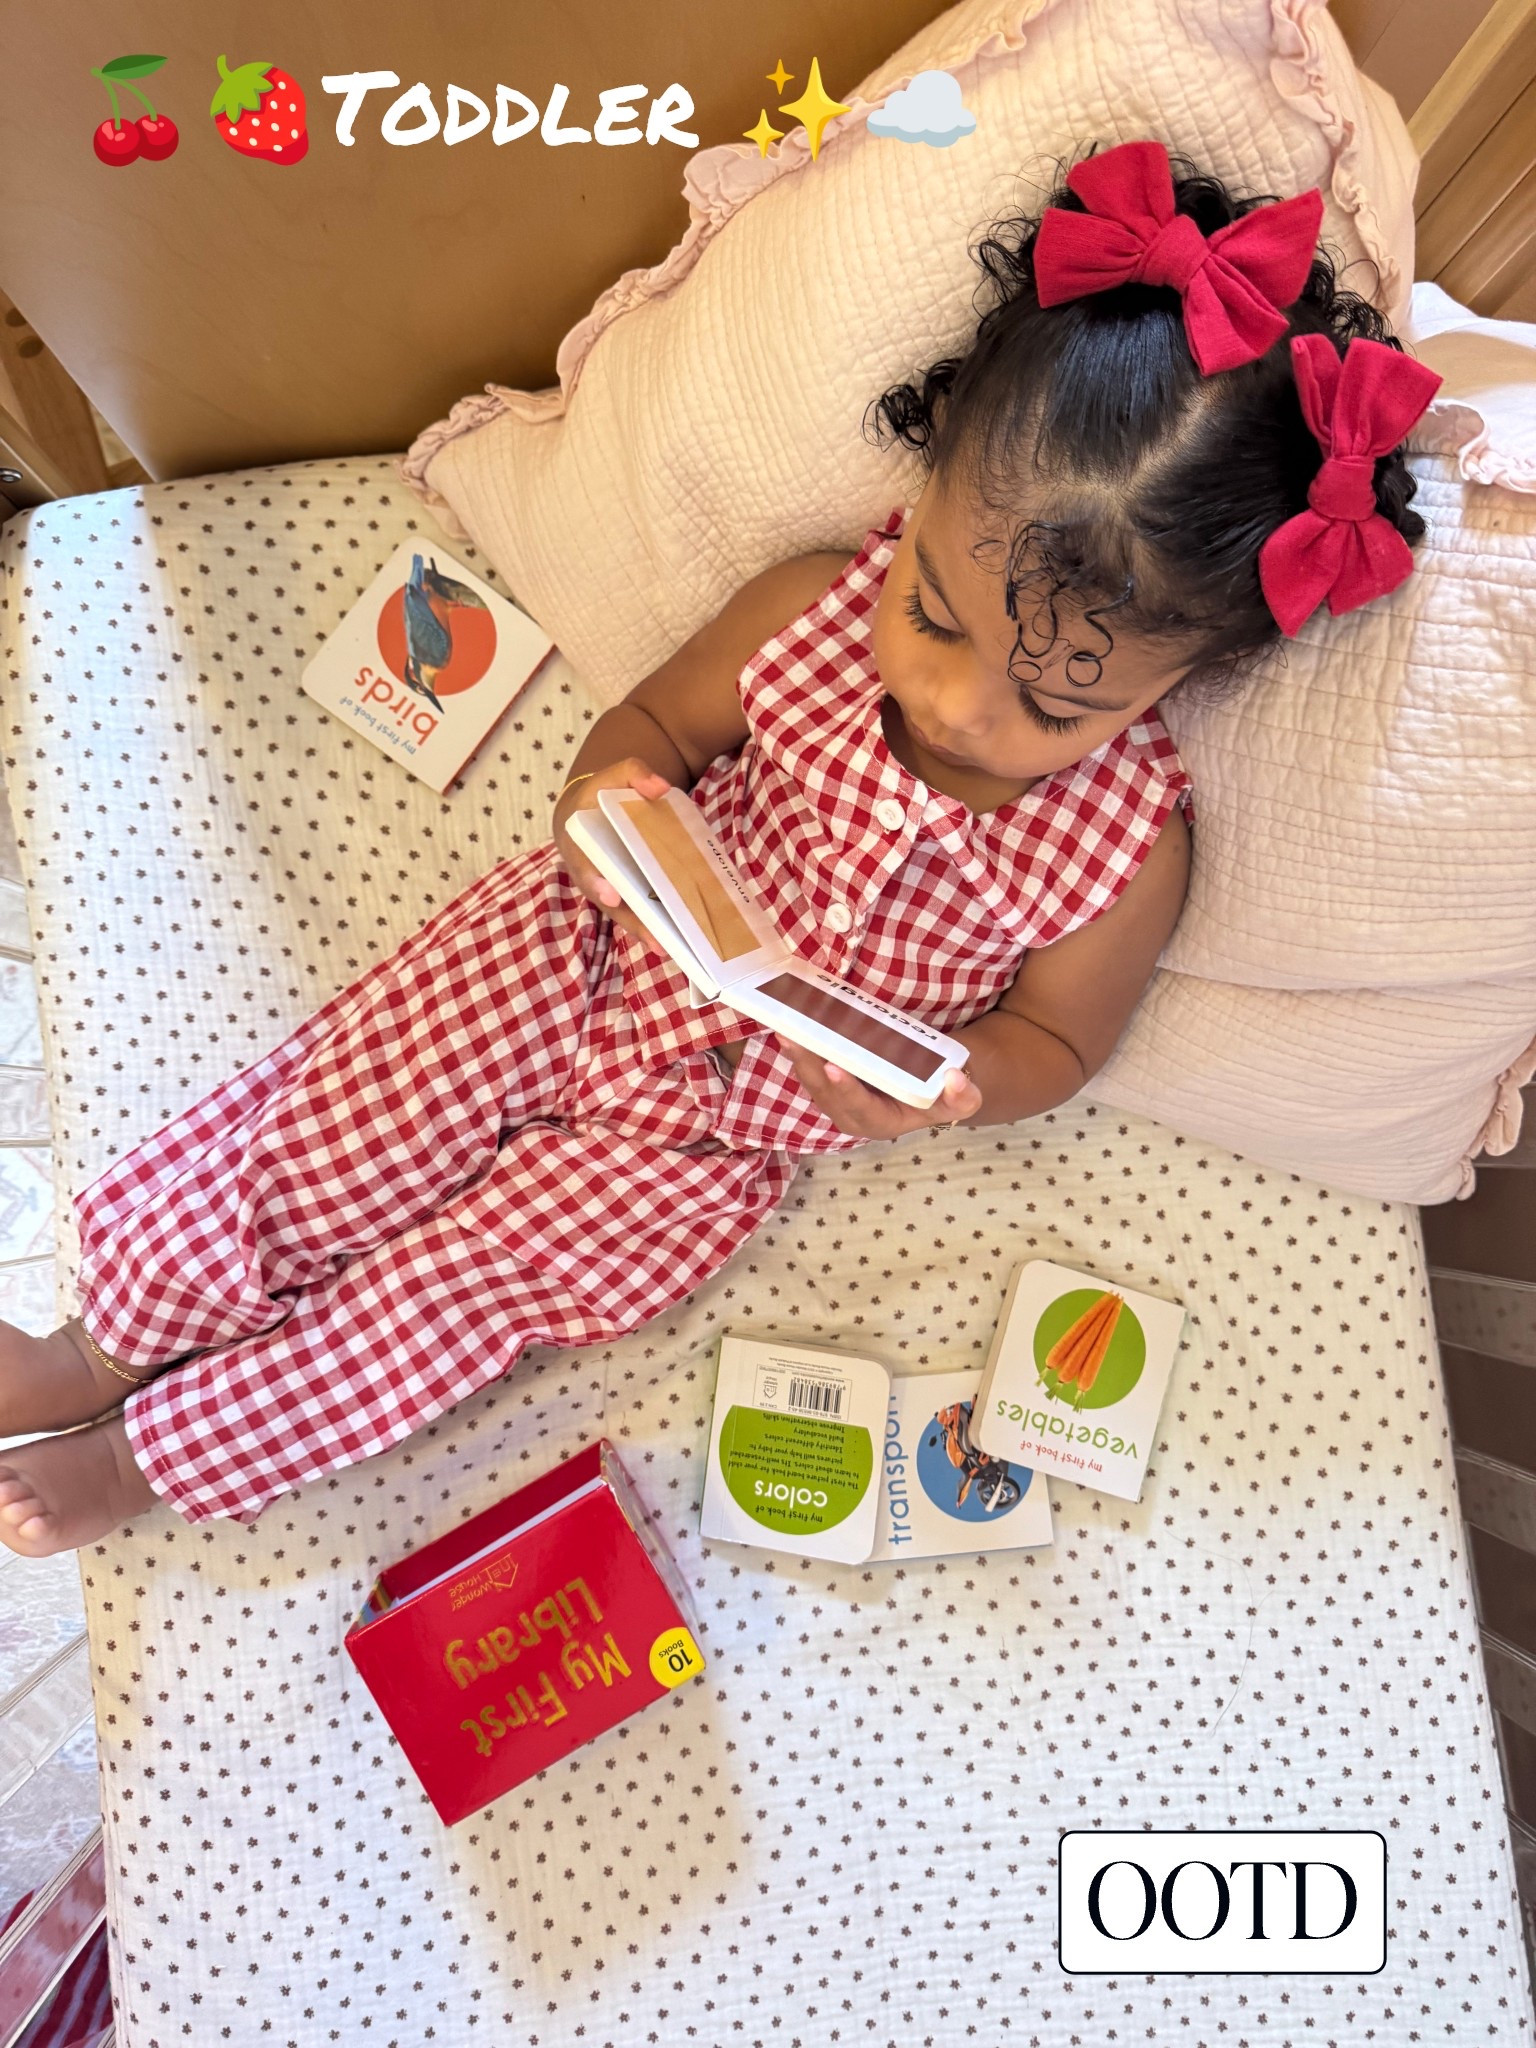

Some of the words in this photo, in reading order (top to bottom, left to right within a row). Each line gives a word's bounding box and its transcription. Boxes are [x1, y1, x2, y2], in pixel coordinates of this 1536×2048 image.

[340, 697, 353, 706] of
[354, 667, 438, 746] birds
[354, 706, 376, 727] book
[376, 724, 400, 744] first
[401, 740, 416, 755] my
[707, 839, 750, 903] envelope
[816, 974, 937, 1041] rectangle
[763, 1413, 779, 1421] skills
[781, 1415, 817, 1427] observation
[819, 1422, 844, 1433] Improve
[996, 1400, 1137, 1459] vegetables
[765, 1433, 783, 1442] colors
[794, 1428, 827, 1439] vocabulary
[829, 1434, 844, 1443] Build
[786, 1438, 814, 1449] different
[816, 1442, 843, 1453] Identify
[1020, 1440, 1032, 1450] of
[758, 1444, 772, 1454] baby
[790, 1449, 802, 1458] help
[1035, 1445, 1058, 1460] book
[804, 1452, 815, 1460] will
[817, 1455, 843, 1465] pictures
[1060, 1453, 1085, 1469] first
[728, 1460, 742, 1469] child
[744, 1462, 757, 1470] your
[1088, 1459, 1102, 1472] my
[761, 1466, 769, 1474] for
[772, 1468, 785, 1477] book
[786, 1471, 804, 1479] board
[816, 1466, 833, 1474] about
[835, 1469, 851, 1477] learn
[806, 1474, 828, 1483] picture
[831, 1478, 845, 1486] first
[755, 1480, 827, 1509] colors
[756, 1505, 764, 1513] of
[768, 1508, 785, 1518] book
[789, 1511, 808, 1521] first
[811, 1513, 822, 1523] my
[444, 1577, 603, 1690] Library
[658, 1639, 684, 1659] Books
[560, 1632, 632, 1690] My
[668, 1649, 692, 1673] 10
[460, 1672, 568, 1757] First
